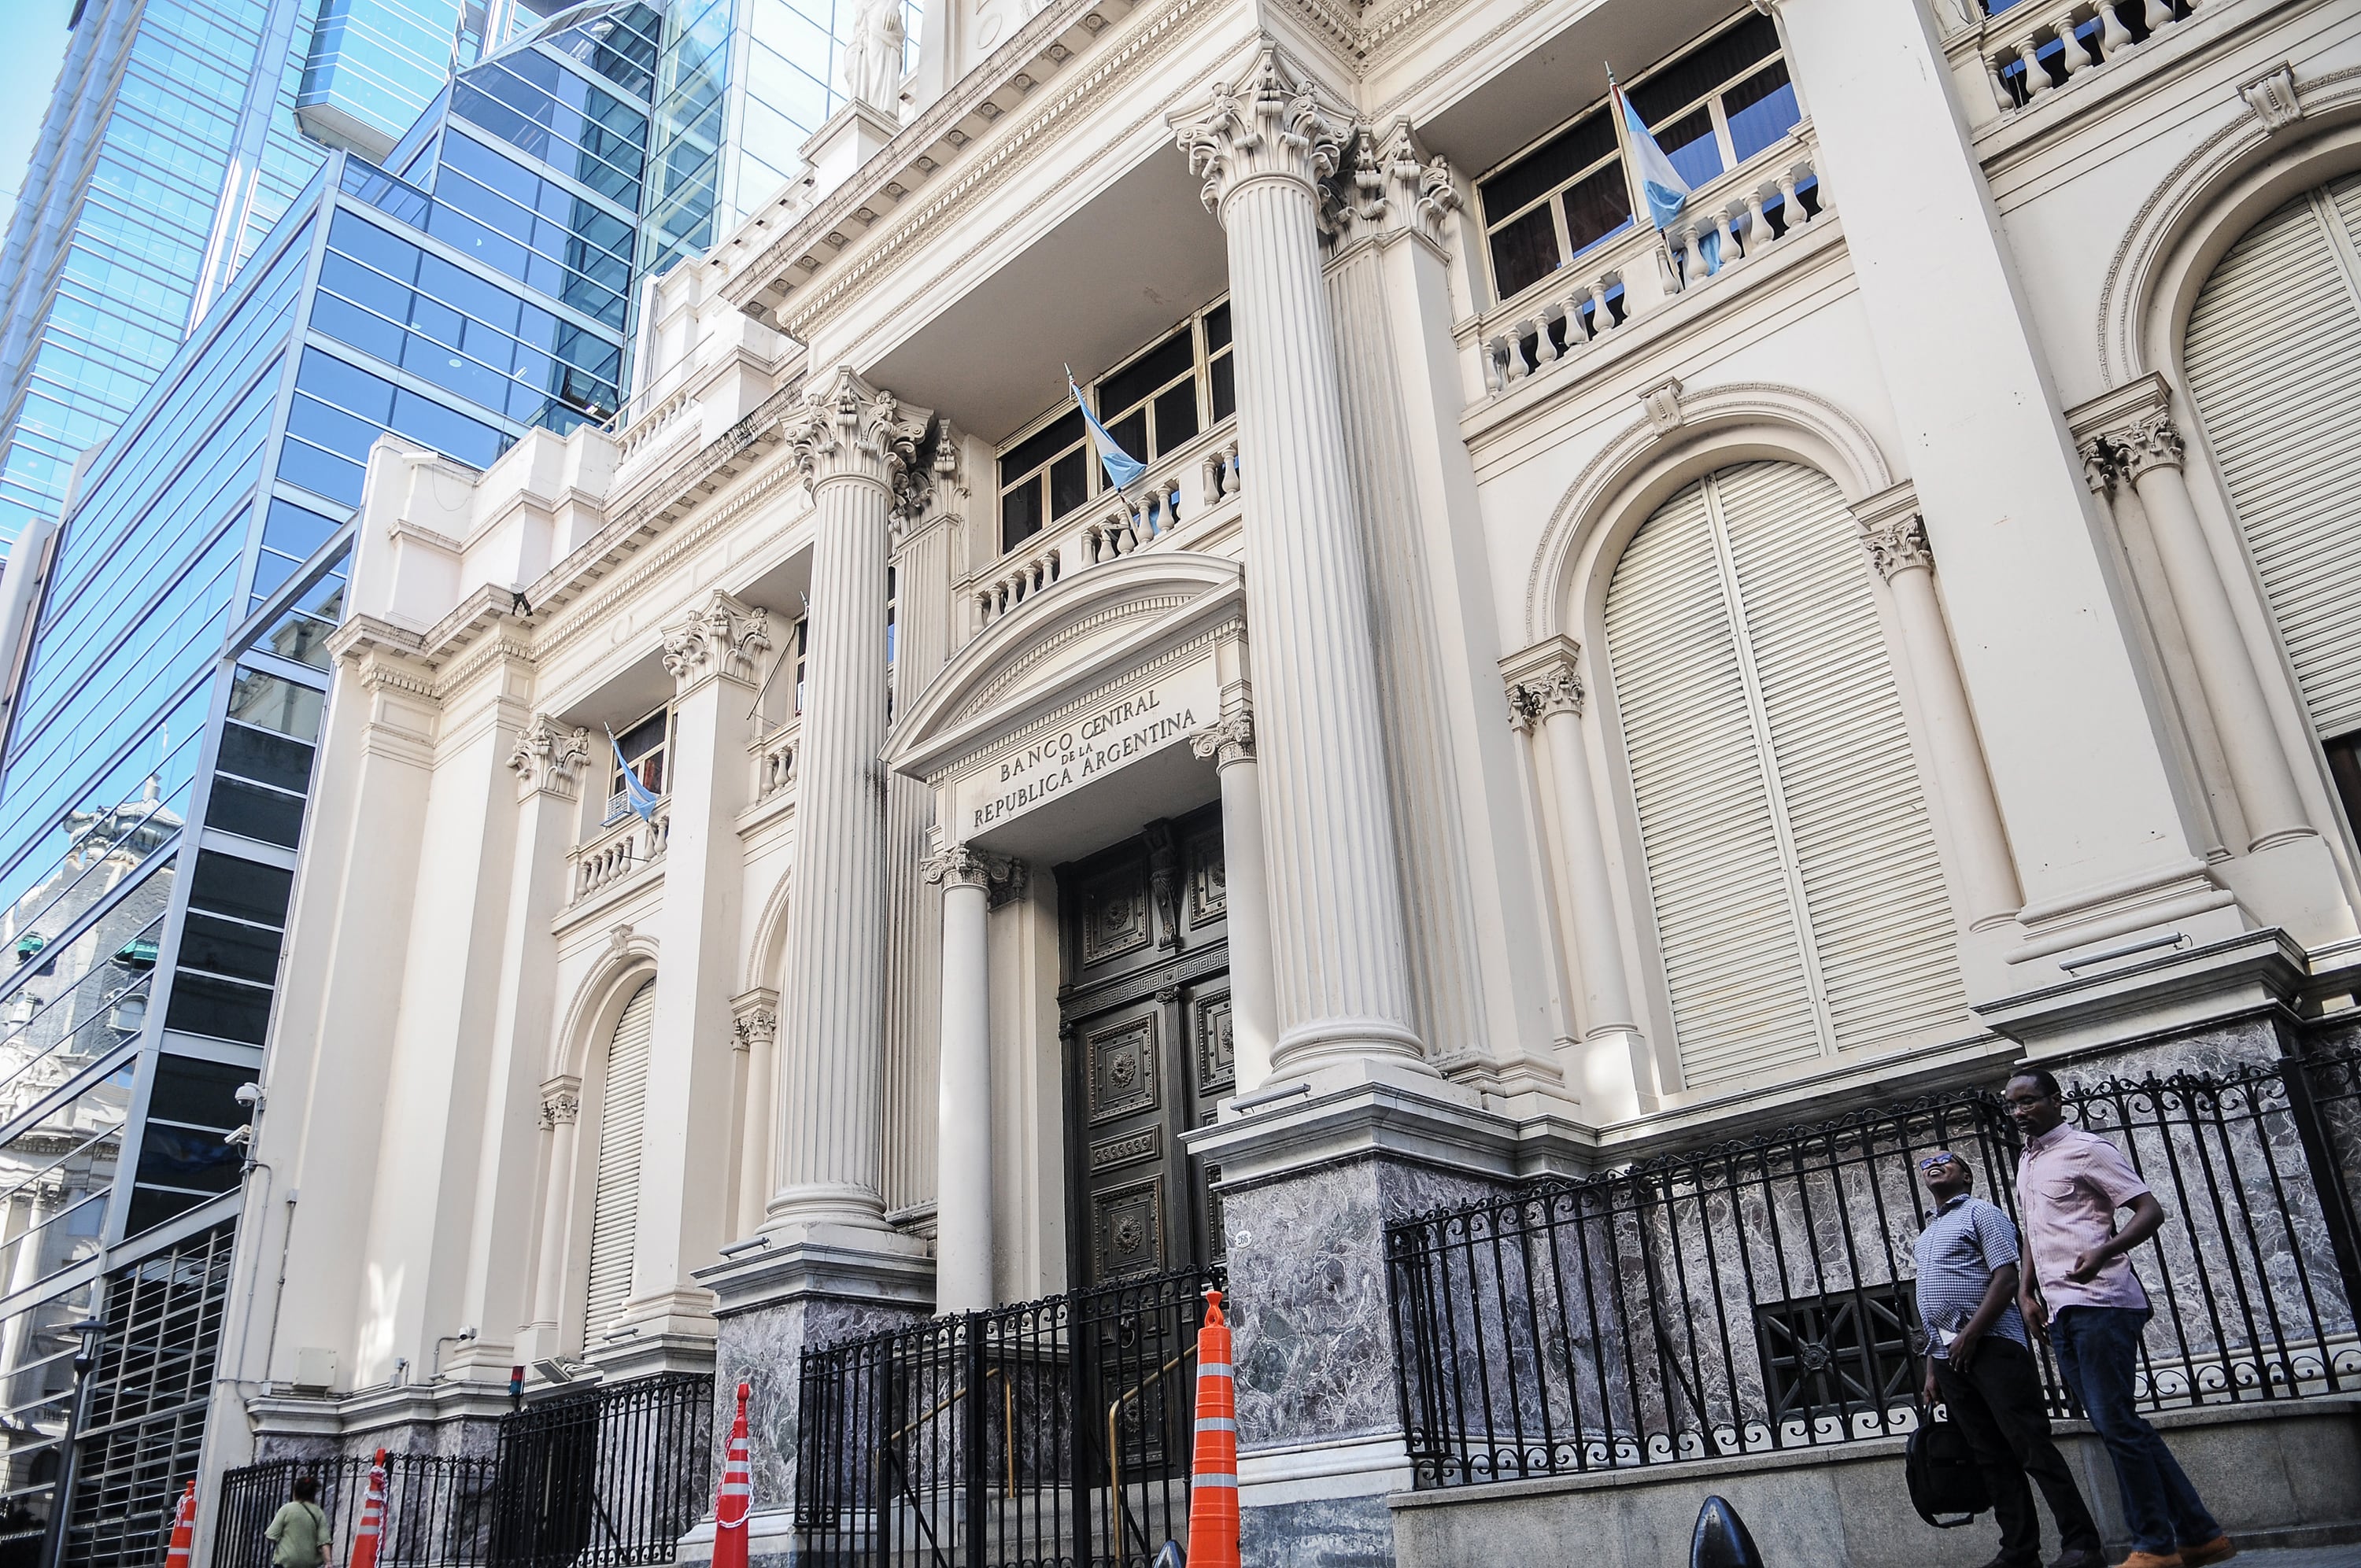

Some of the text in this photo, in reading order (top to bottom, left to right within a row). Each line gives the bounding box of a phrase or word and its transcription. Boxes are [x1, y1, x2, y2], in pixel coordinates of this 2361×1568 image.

[1000, 690, 1160, 782] BANCO CENTRAL
[1061, 743, 1093, 766] DE LA
[974, 707, 1196, 828] REPUBLICA ARGENTINA
[1237, 1234, 1248, 1245] 266
